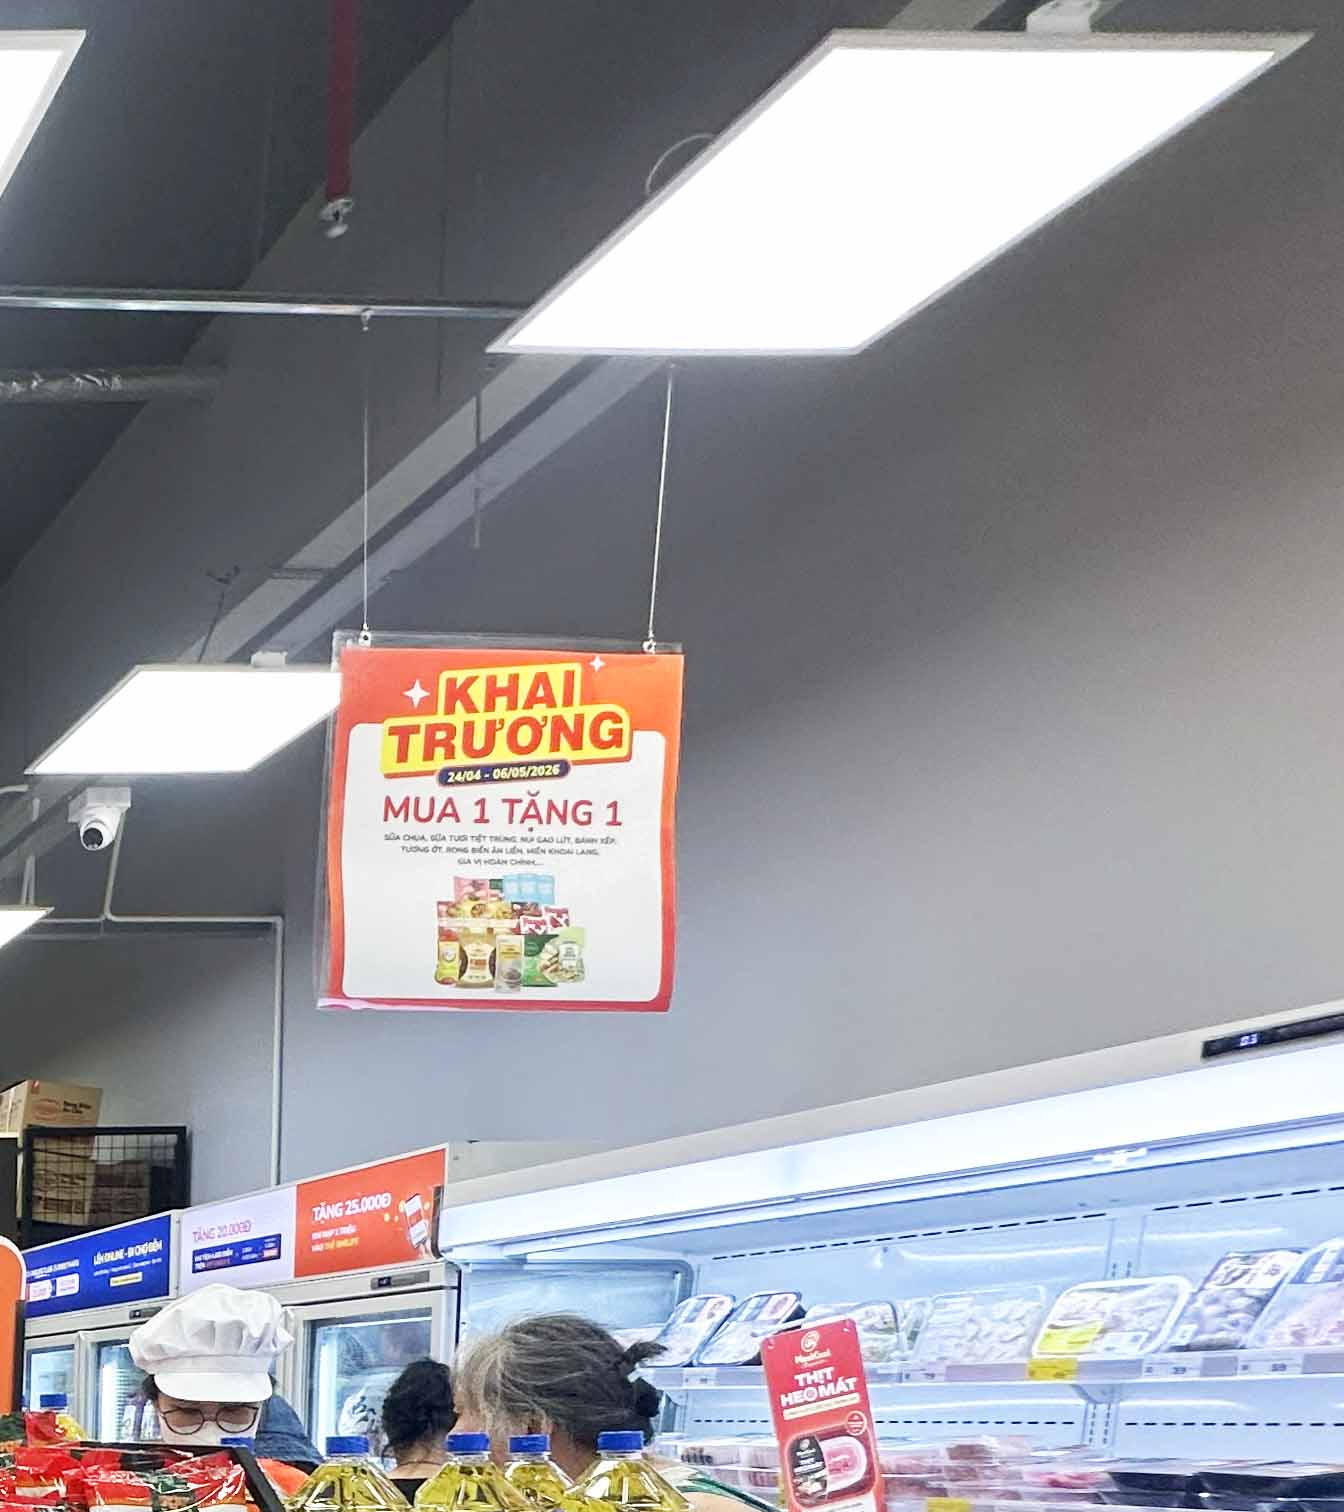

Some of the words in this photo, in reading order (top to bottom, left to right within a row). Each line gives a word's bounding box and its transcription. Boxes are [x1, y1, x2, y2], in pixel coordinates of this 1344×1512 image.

[443, 671, 575, 714] KHAI
[388, 712, 624, 763] TRƯƠNG
[447, 770, 480, 783] 24/04
[493, 765, 560, 780] 06/05/2026
[383, 796, 461, 824] MUA
[473, 798, 490, 823] 1
[502, 790, 593, 832] TẶNG
[607, 800, 622, 826] 1
[312, 1201, 344, 1228] TẶNG
[344, 1192, 391, 1215] 25.000Đ
[780, 1386, 818, 1407] HEO
[820, 1377, 858, 1397] MÁT
[794, 1366, 835, 1387] THỊT
